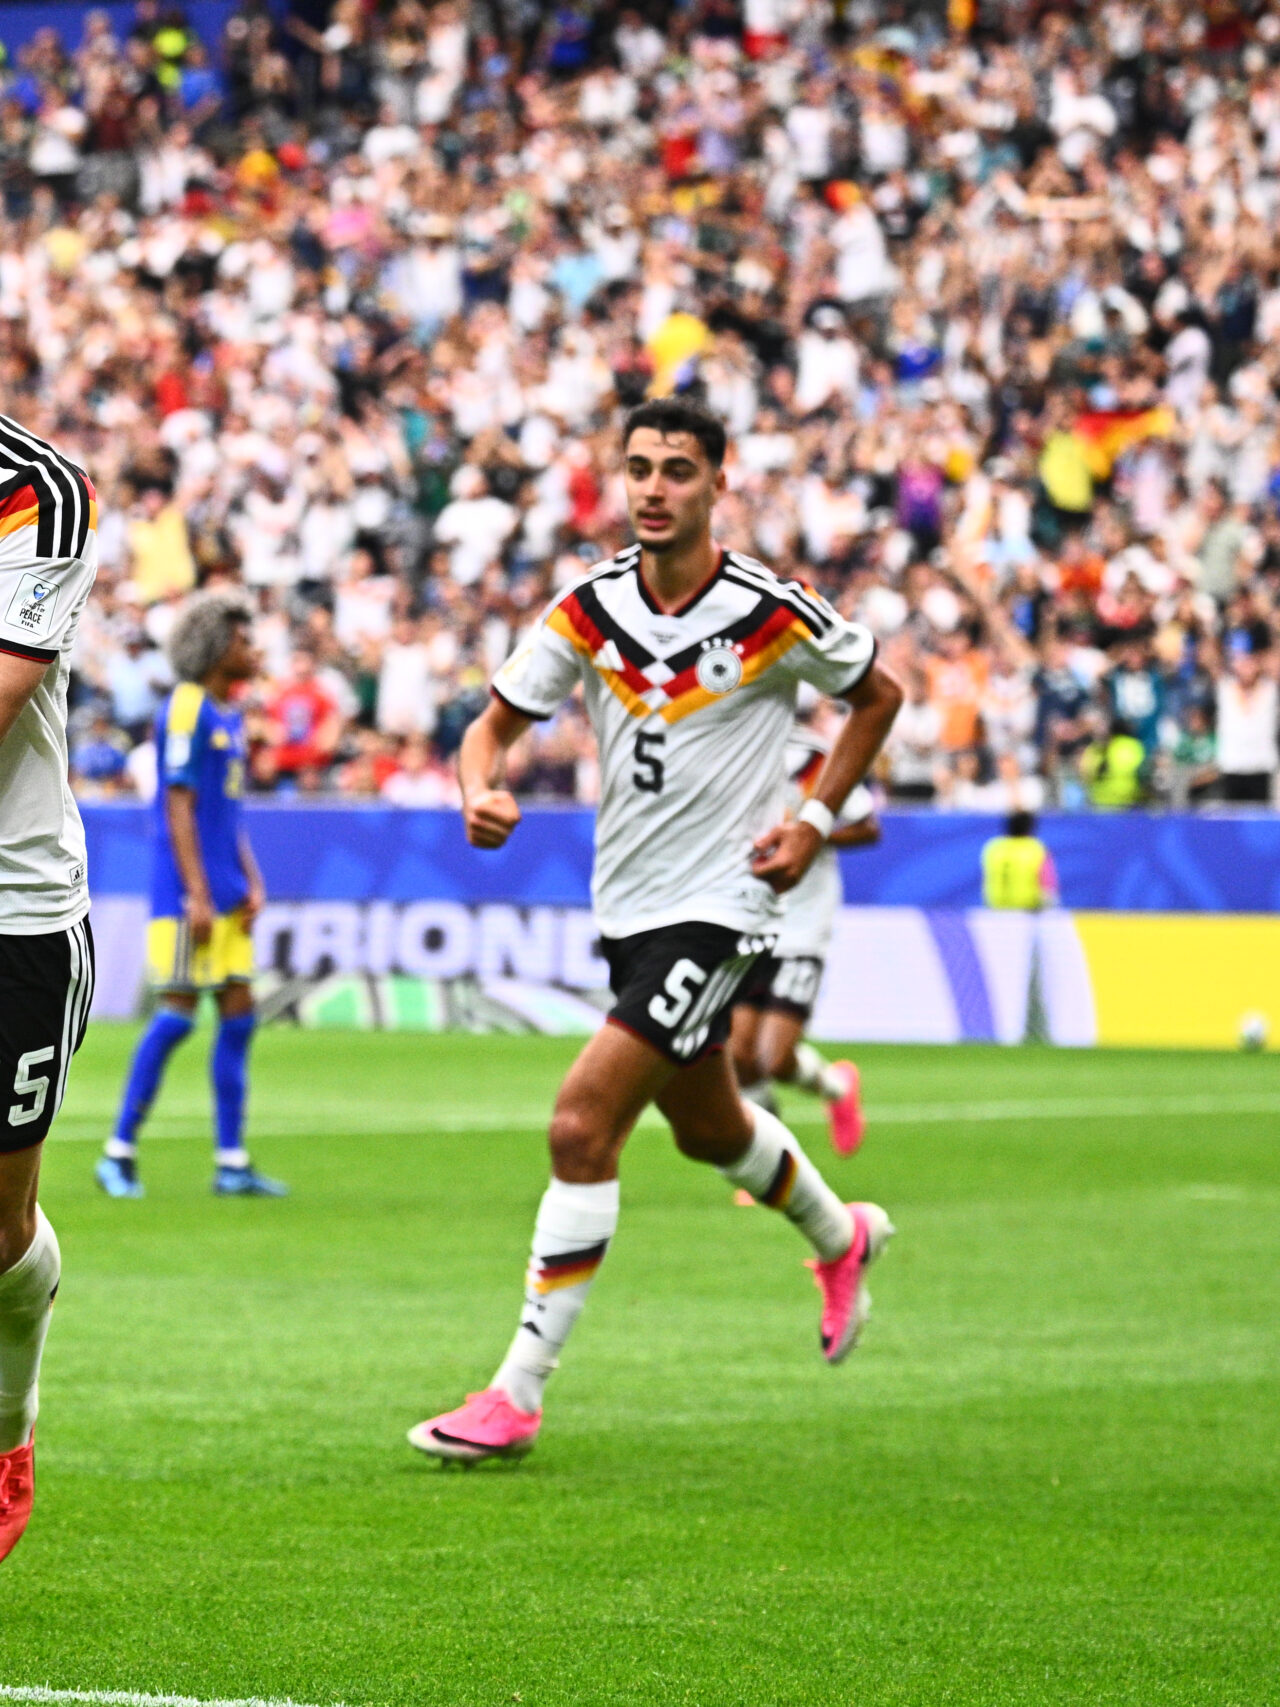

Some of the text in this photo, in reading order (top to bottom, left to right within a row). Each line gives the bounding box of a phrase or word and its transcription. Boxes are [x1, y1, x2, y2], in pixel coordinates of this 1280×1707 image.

[19, 608, 42, 624] PEACE
[633, 729, 665, 794] 5
[648, 957, 707, 1029] 5
